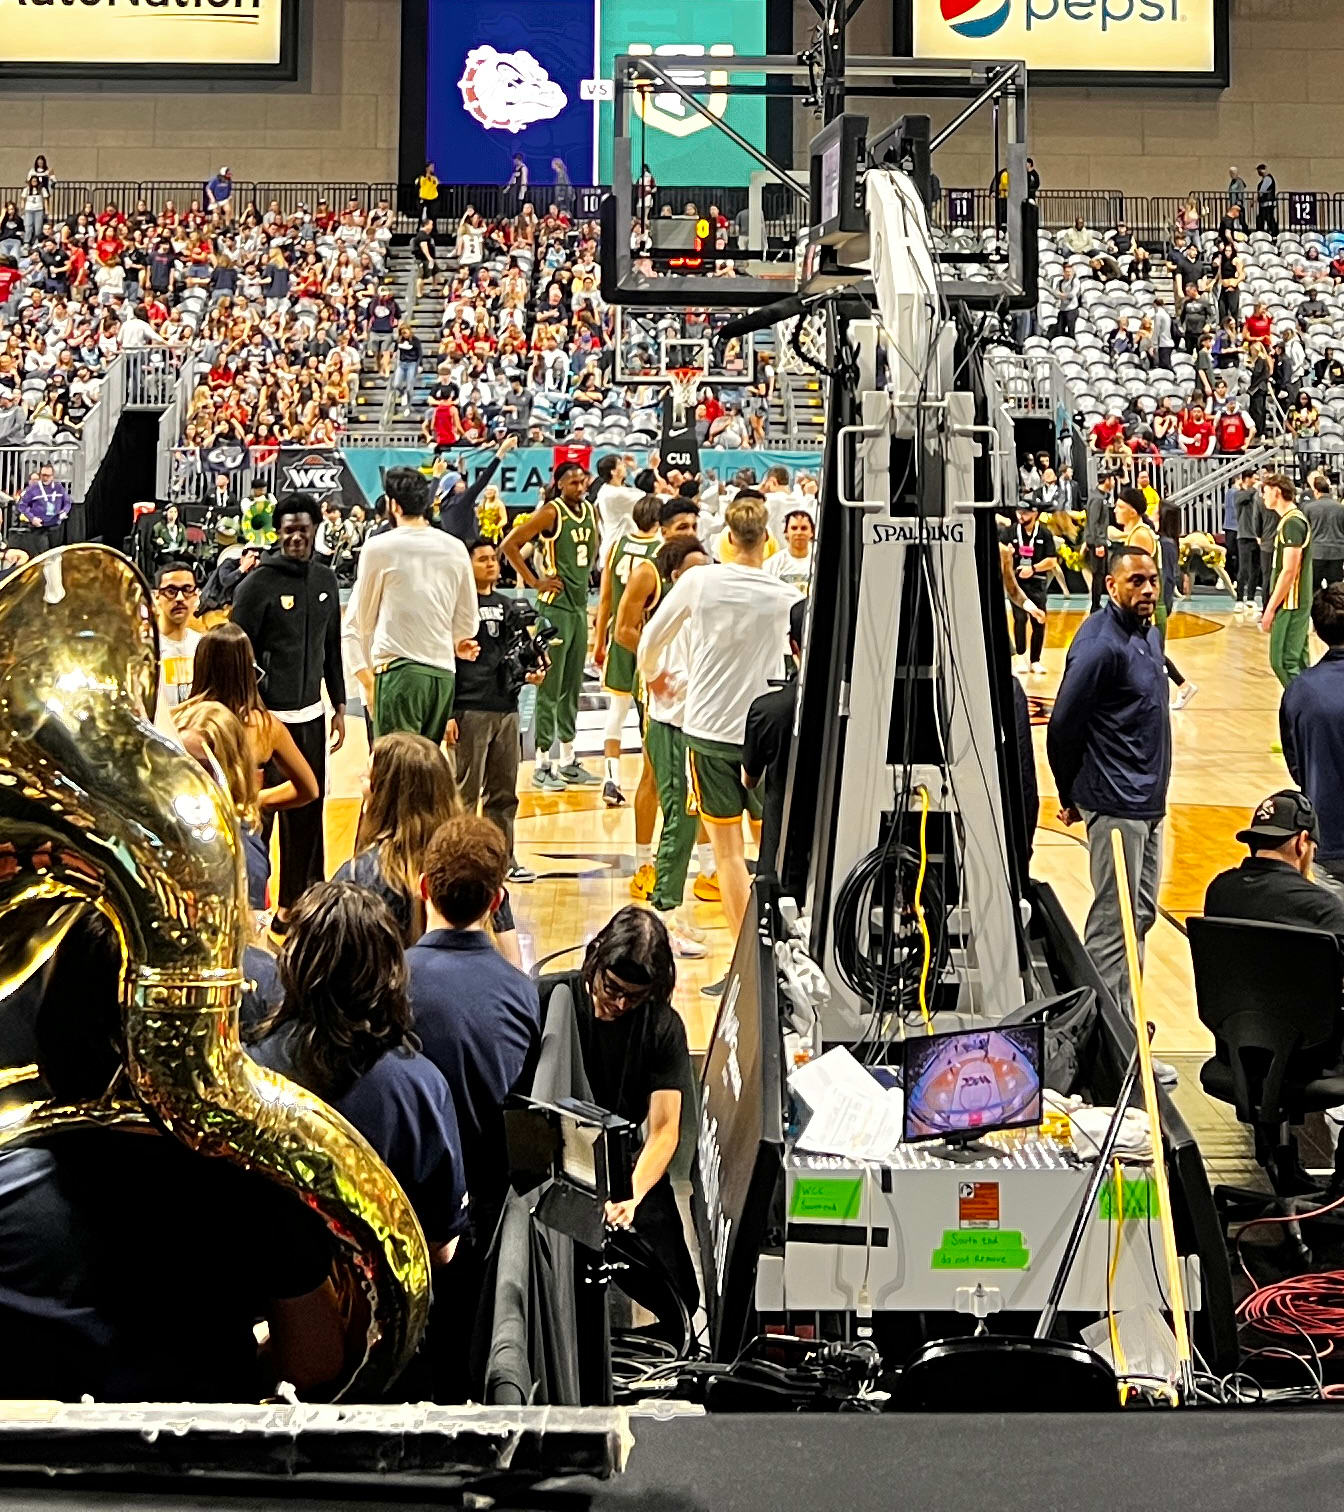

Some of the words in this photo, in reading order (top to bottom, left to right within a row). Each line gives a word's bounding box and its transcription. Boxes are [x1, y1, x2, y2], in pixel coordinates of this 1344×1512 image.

[587, 84, 608, 97] VS
[583, 195, 599, 213] 10
[954, 199, 967, 216] 11
[1295, 202, 1311, 220] 12
[288, 468, 339, 489] WCC
